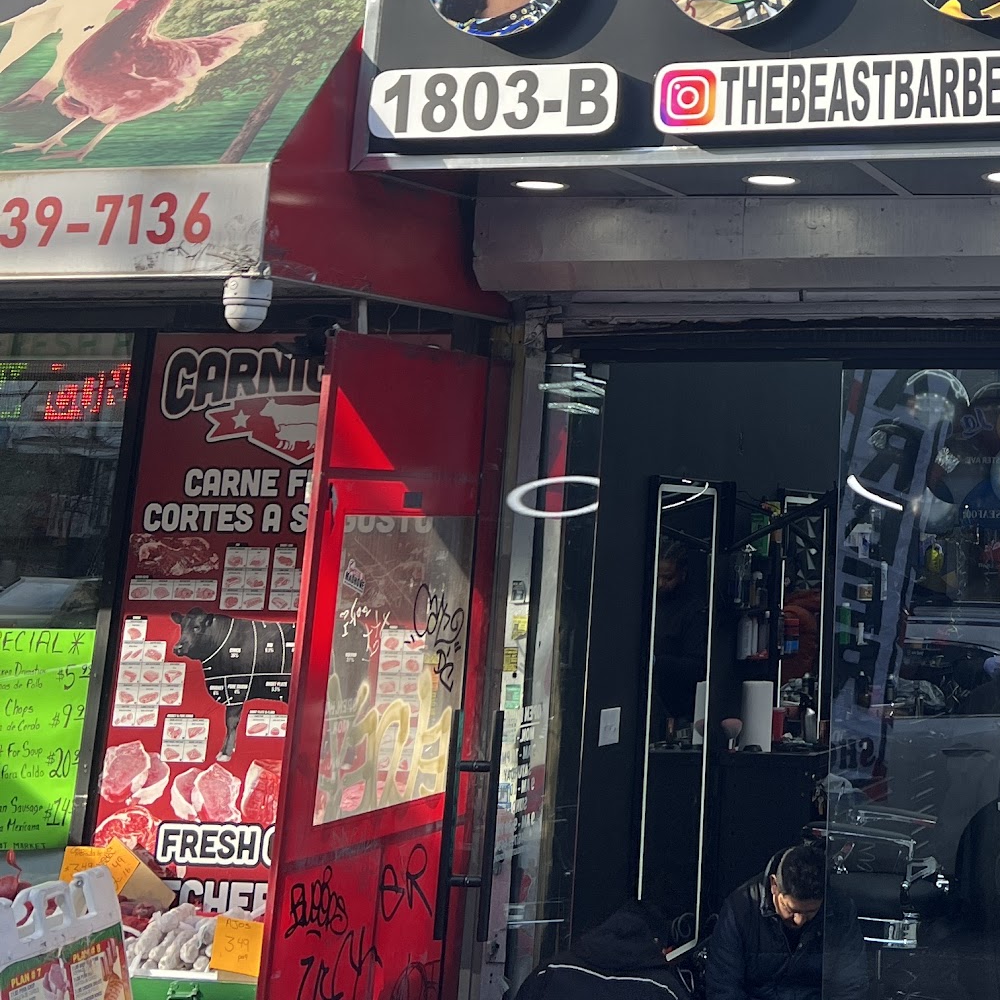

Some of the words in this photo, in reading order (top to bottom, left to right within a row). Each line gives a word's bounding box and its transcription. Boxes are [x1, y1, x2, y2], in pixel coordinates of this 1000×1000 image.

[383, 67, 609, 133] 1803-B
[184, 469, 279, 496] CARNE
[143, 503, 254, 532] CORTES
[261, 503, 282, 532] A
[0, 631, 63, 653] ECIAL
[21, 763, 44, 779] Caldo
[158, 826, 260, 862] FRESH
[10, 974, 29, 989] PLAN
